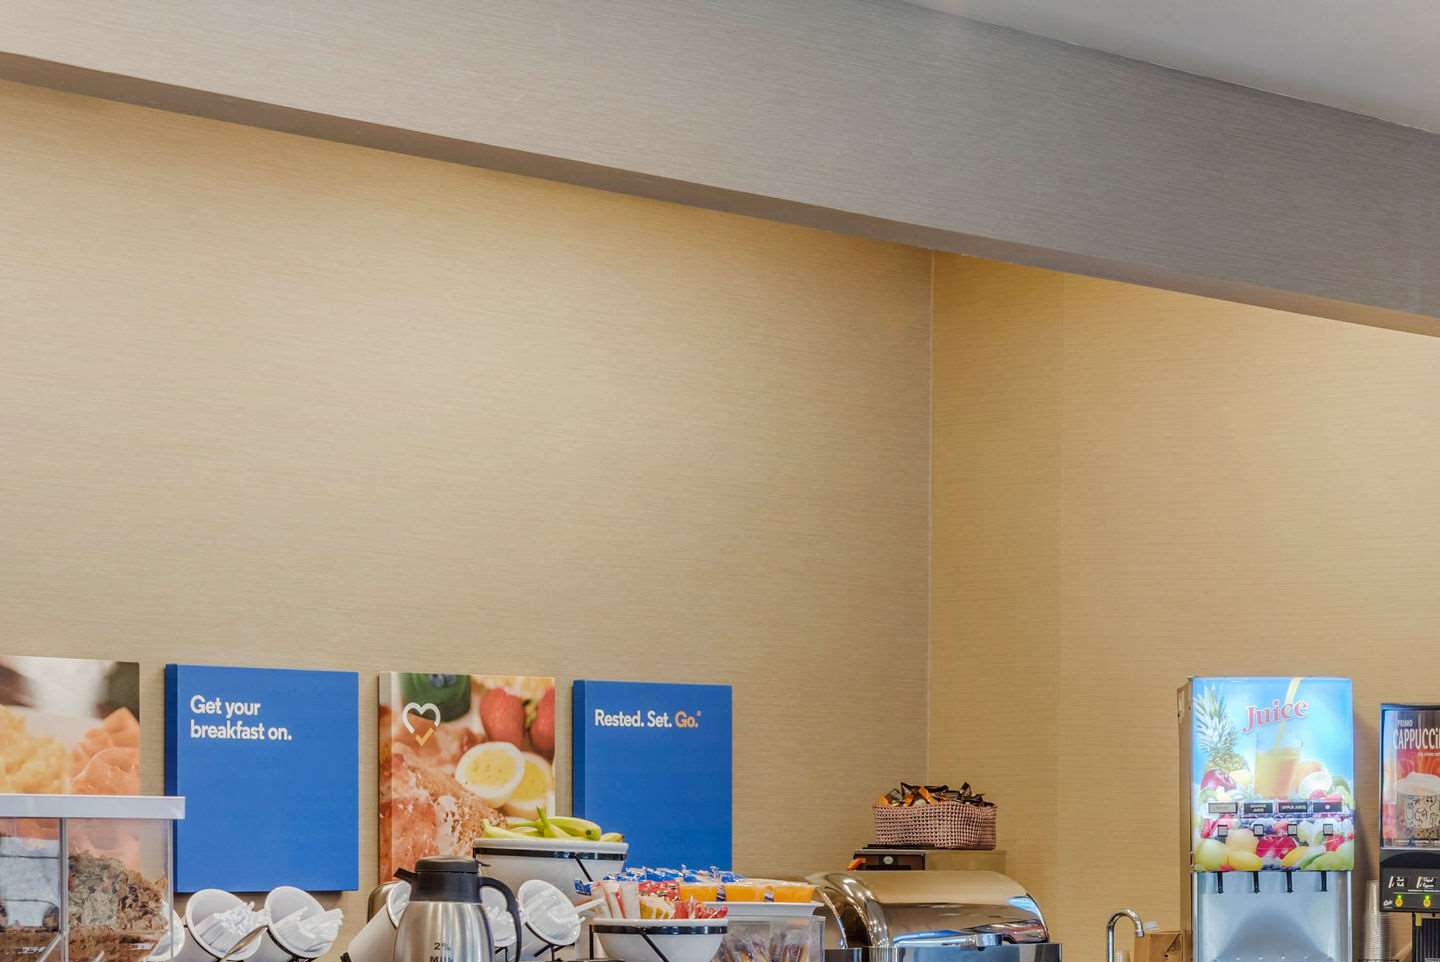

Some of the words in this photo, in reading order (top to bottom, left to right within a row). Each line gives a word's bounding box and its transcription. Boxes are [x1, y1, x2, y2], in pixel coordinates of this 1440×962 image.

[190, 694, 222, 714] Get
[225, 702, 261, 719] your
[594, 708, 645, 727] Rested.
[646, 710, 672, 728] Set.
[1242, 698, 1309, 733] Juice
[190, 719, 265, 740] breakfast
[267, 726, 293, 741] on.
